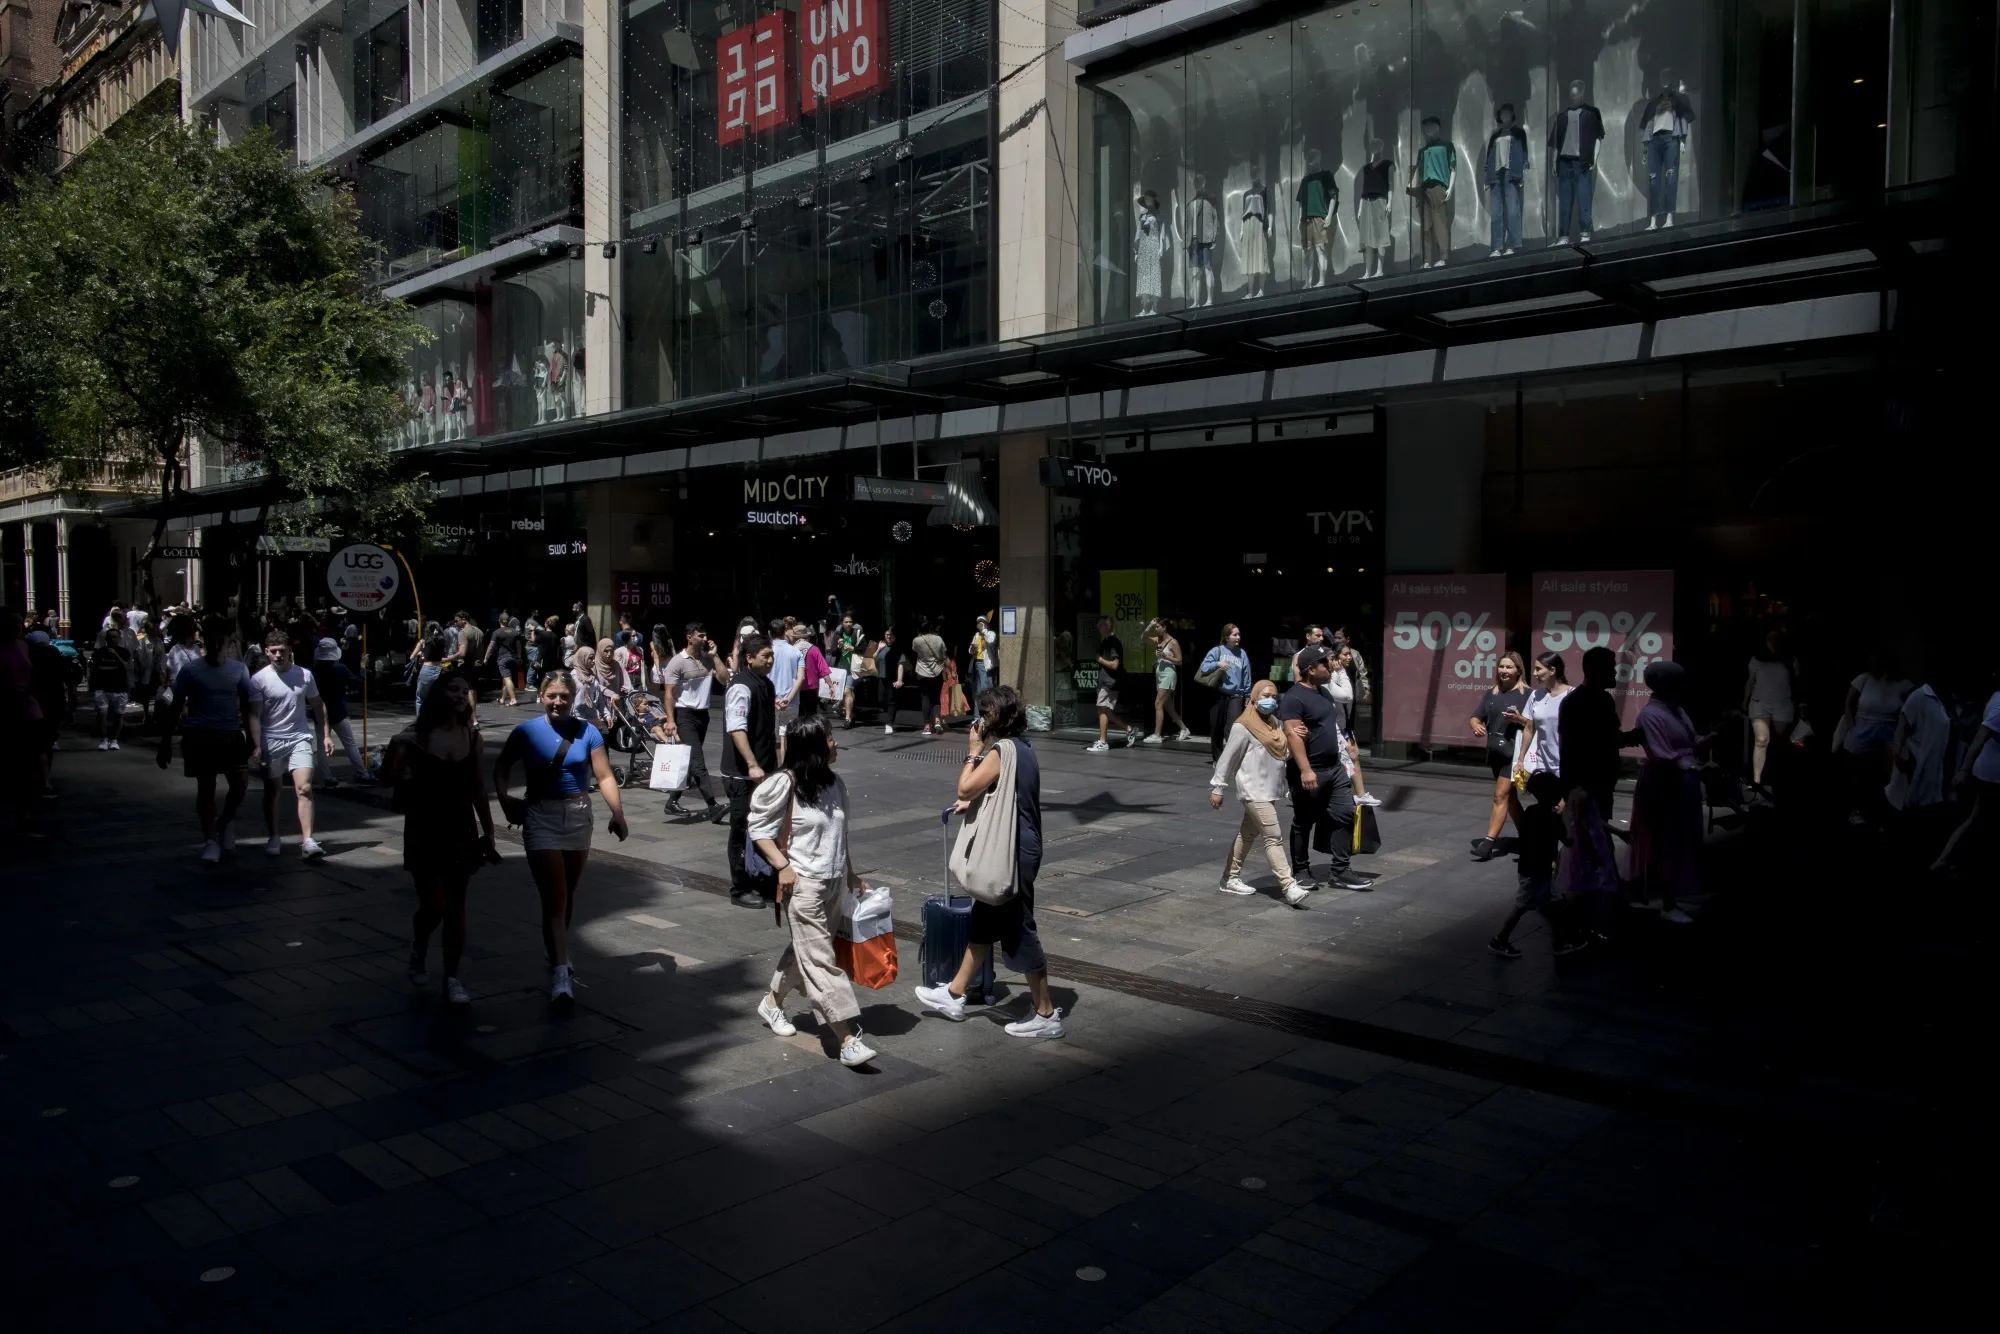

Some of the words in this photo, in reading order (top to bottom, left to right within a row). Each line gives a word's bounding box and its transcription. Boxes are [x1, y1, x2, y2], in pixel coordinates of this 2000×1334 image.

[809, 0, 863, 45] UNI
[810, 36, 869, 98] QLO
[1073, 465, 1112, 487] TYPO
[893, 485, 909, 496] level
[909, 487, 915, 496] 2
[511, 517, 546, 531] rebel
[163, 548, 201, 557] GOELIA
[344, 552, 384, 569] UGG
[651, 582, 670, 593] UNI
[1391, 582, 1406, 595] All
[1408, 582, 1431, 595] sale
[1433, 582, 1468, 597] styles
[1540, 579, 1558, 593] All
[1560, 578, 1586, 593] sale
[1589, 579, 1629, 597] styles
[651, 594, 671, 606] QLO
[1114, 592, 1144, 607] 30%
[1115, 607, 1143, 621] OFF
[1392, 611, 1497, 652] 50%
[1541, 610, 1663, 655] 50%
[1454, 652, 1496, 679] off
[1615, 655, 1663, 684] of
[1073, 670, 1099, 680] ACTU
[1076, 679, 1098, 688] WAN
[1447, 681, 1473, 691] original
[1636, 688, 1652, 697] pric
